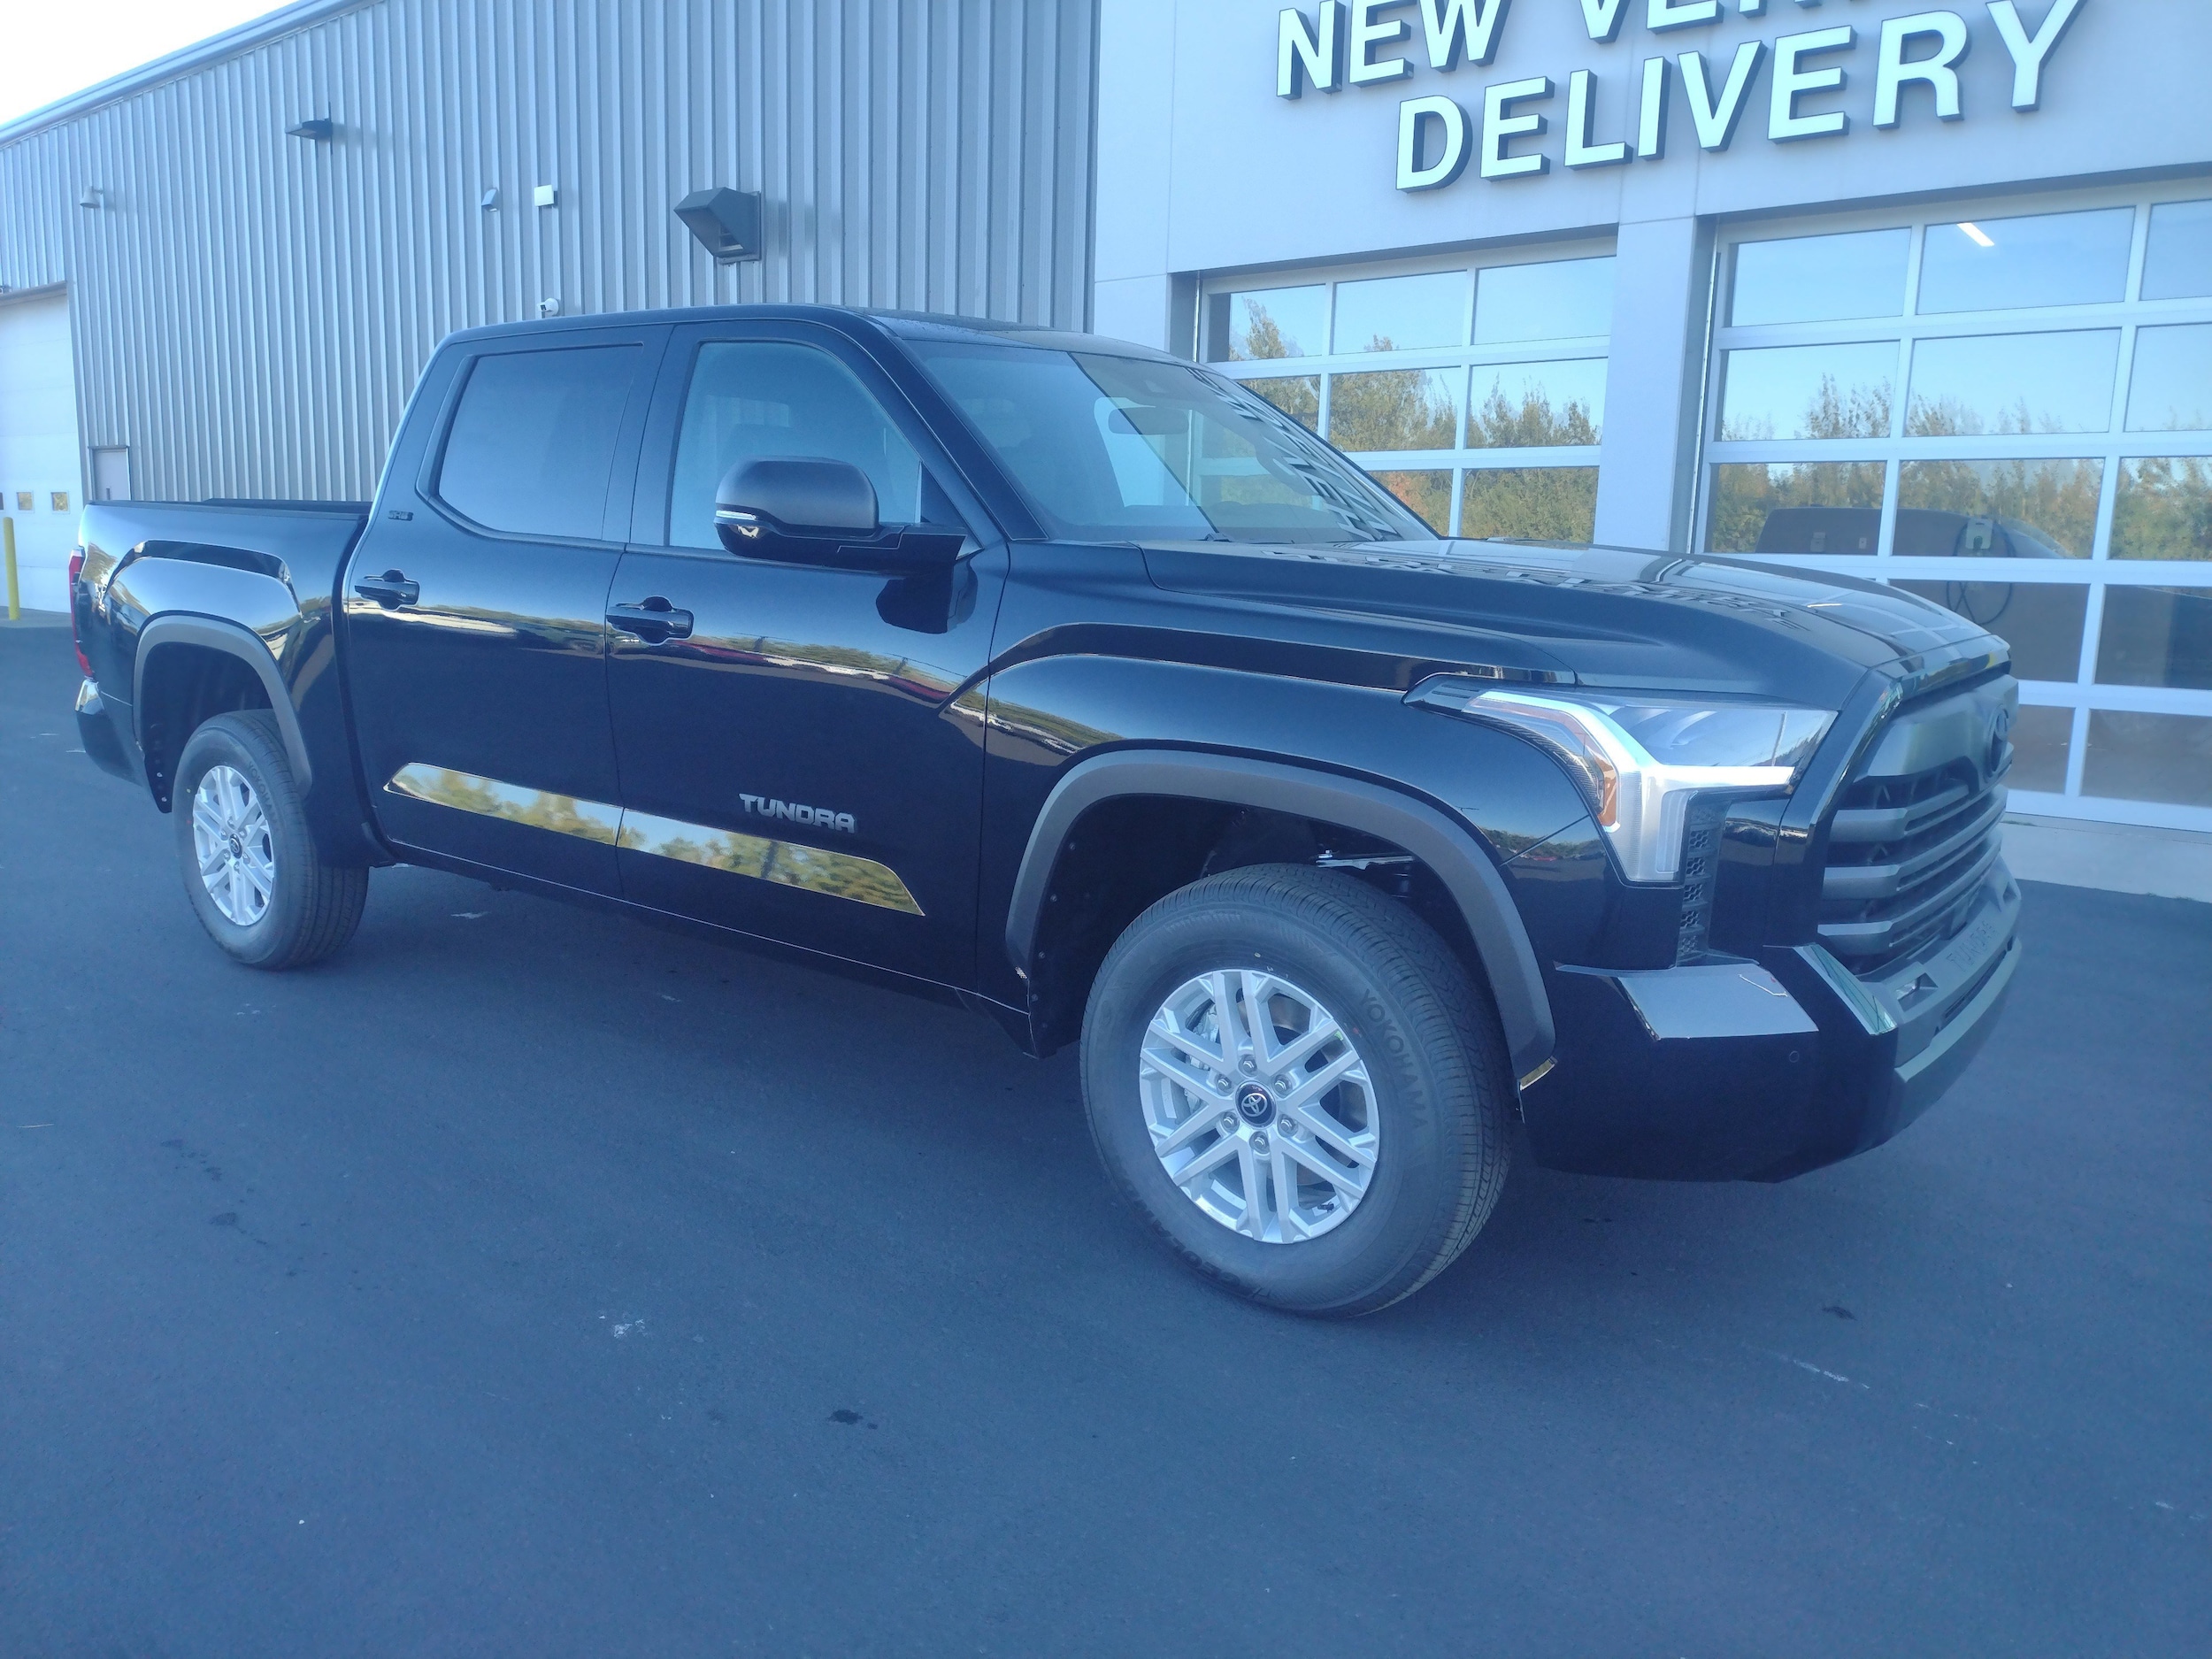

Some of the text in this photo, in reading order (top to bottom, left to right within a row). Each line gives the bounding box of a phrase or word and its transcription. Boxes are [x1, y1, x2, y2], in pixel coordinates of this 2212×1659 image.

[1276, 0, 1509, 99] NEW
[1395, 0, 2085, 192] DELIVERY
[738, 793, 856, 833] TUNDRA
[1358, 987, 1429, 1128] YOKOHAMA
